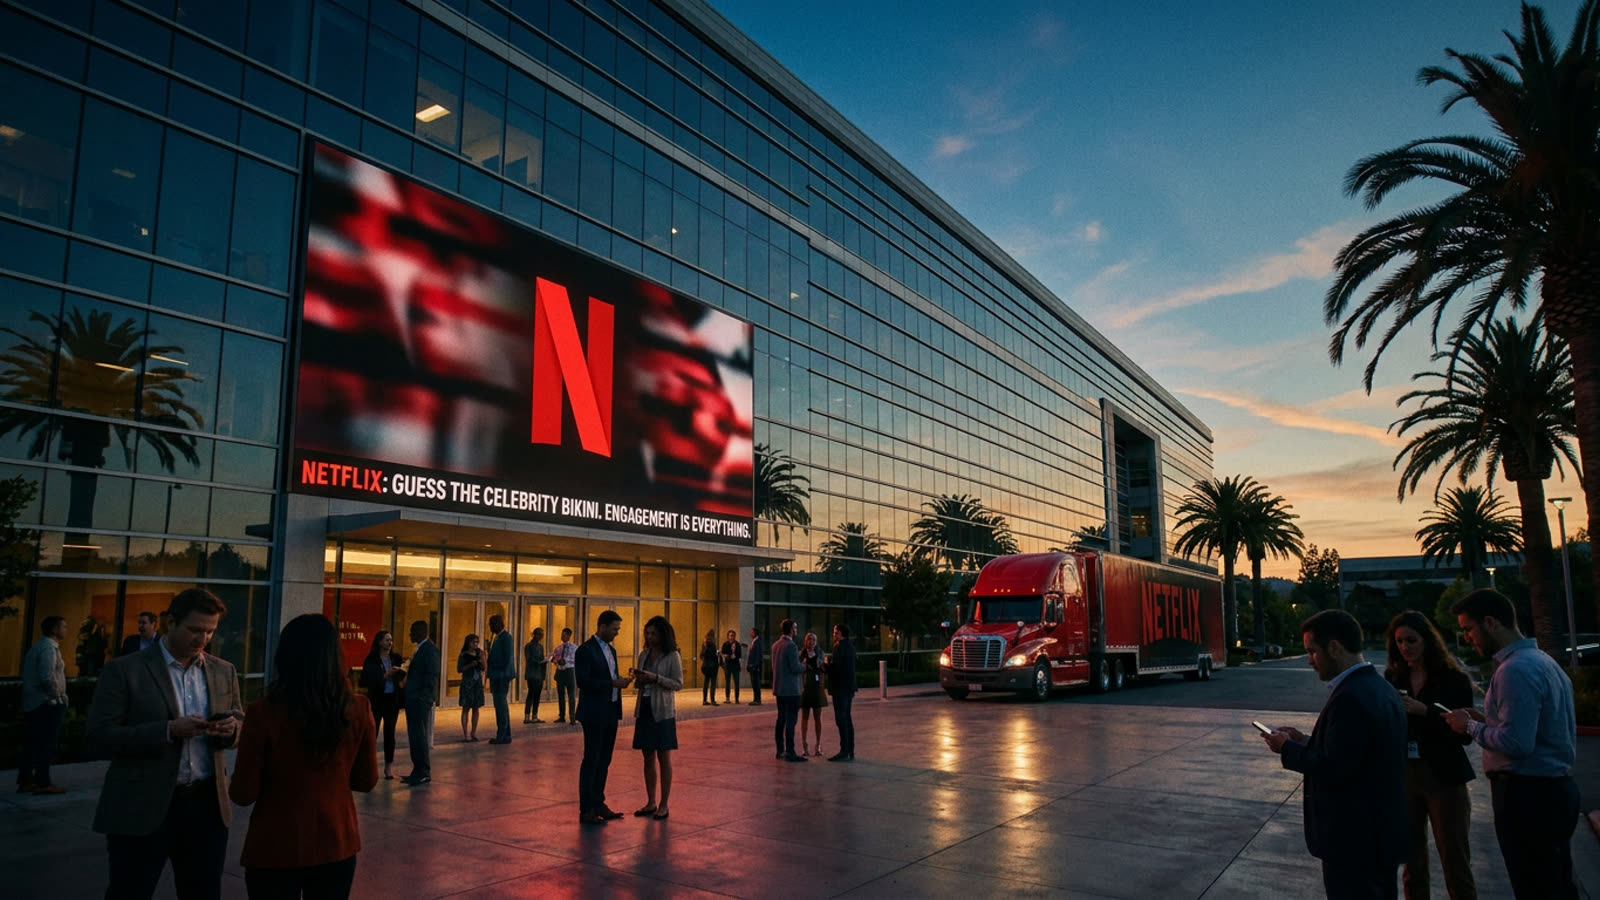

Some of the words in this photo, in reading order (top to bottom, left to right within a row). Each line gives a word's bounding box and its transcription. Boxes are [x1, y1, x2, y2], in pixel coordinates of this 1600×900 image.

[530, 275, 615, 458] N
[301, 459, 388, 495] NETFLIX:
[391, 473, 447, 500] GUESS
[450, 481, 481, 505] THE
[483, 486, 559, 514] CELEBRITY
[561, 497, 602, 520] BIKINI.
[605, 503, 678, 529] ENGAGEMENT
[680, 514, 690, 531] IS
[692, 516, 752, 539] EVERYTHING.
[1141, 581, 1202, 646] NETFLIX
